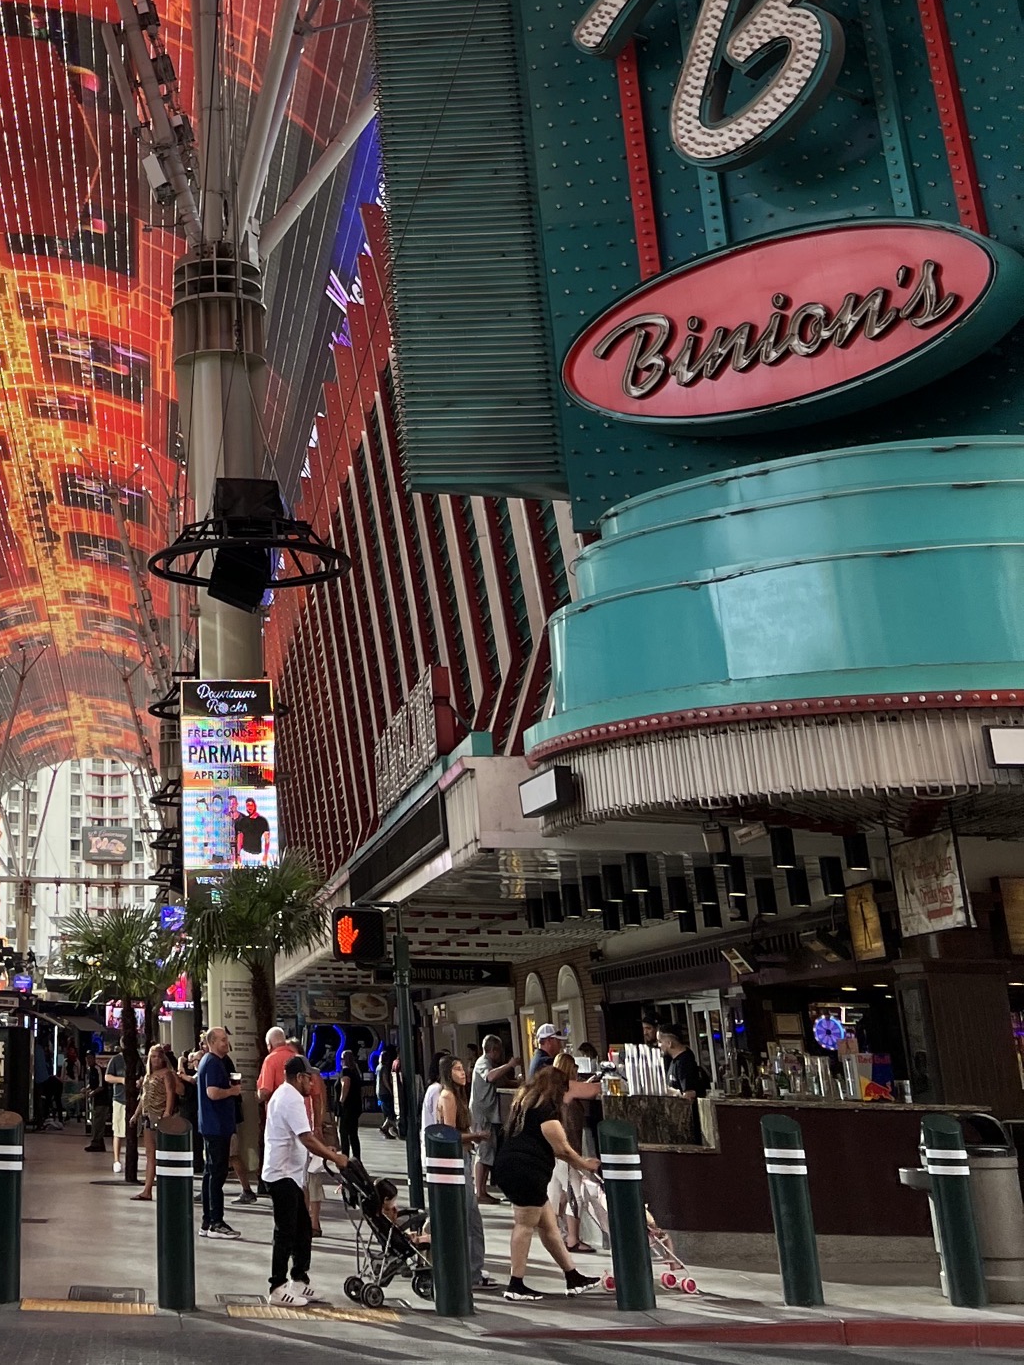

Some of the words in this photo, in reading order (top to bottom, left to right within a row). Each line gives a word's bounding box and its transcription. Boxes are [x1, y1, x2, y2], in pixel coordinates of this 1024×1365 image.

[592, 258, 958, 402] Binion's
[196, 683, 257, 699] Downtown
[187, 728, 214, 738] FREE
[216, 728, 268, 738] CONCERT
[188, 744, 269, 764] PARMALEE
[193, 770, 214, 780] APR
[216, 769, 230, 780] 23
[410, 967, 451, 981] BINION'S
[453, 966, 475, 981] CAFÉ
